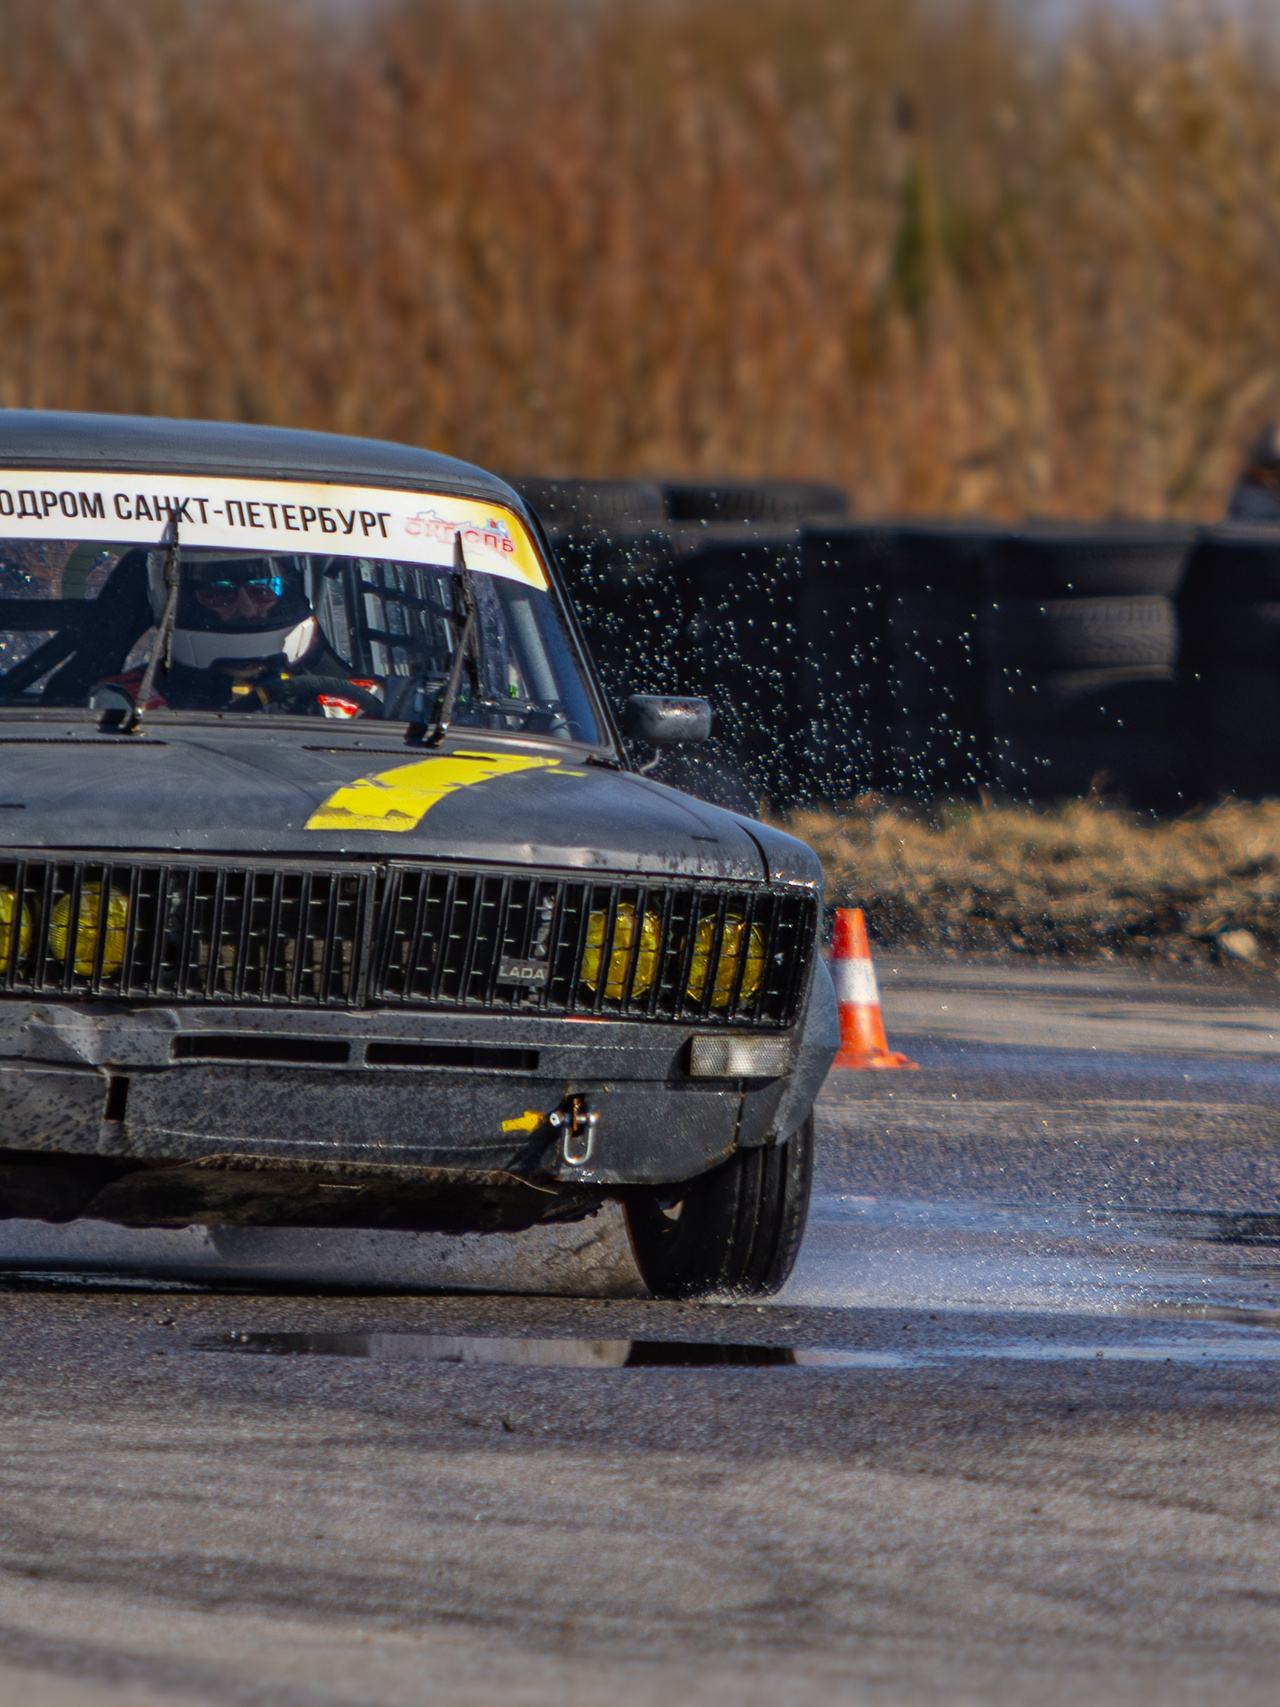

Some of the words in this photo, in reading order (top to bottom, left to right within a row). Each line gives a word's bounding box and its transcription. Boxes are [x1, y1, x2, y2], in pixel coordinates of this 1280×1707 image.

[113, 493, 392, 539] САНКТ-ПЕТЕРБУРГ
[464, 530, 515, 553] СПБ
[499, 965, 546, 980] LADA
